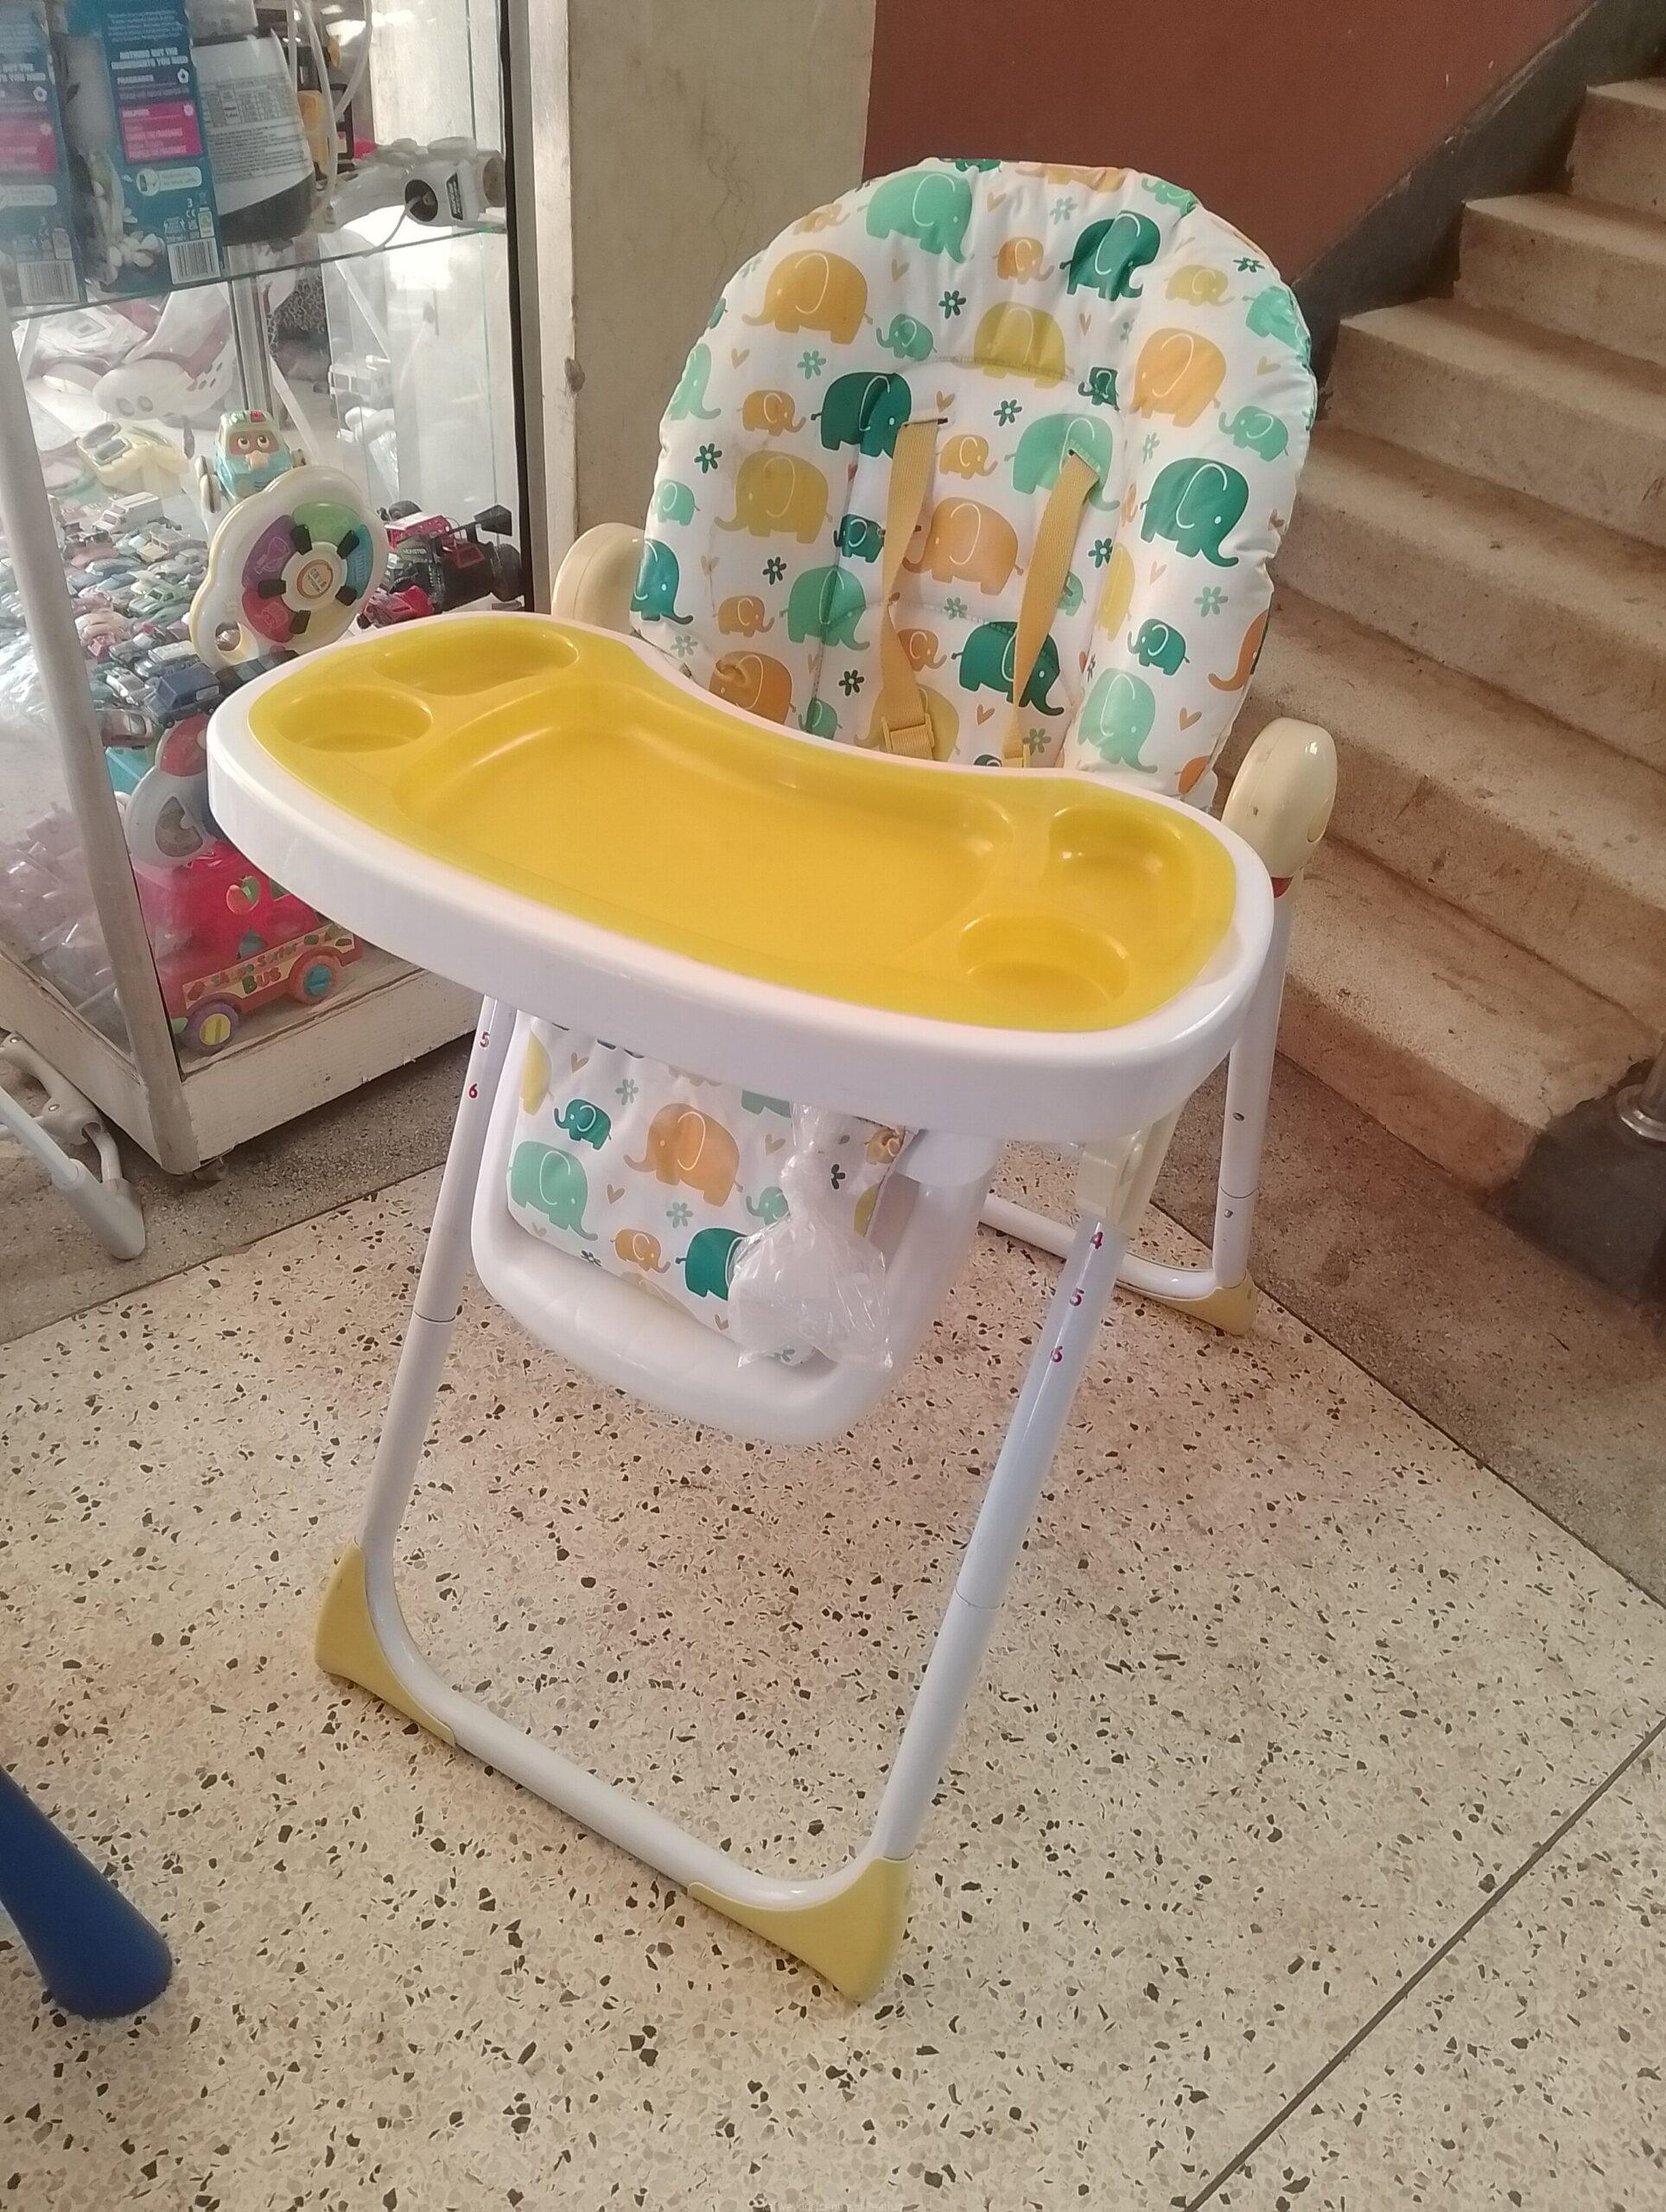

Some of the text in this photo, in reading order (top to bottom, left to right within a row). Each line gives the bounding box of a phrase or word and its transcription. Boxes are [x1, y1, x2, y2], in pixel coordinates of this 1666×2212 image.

[480, 1031, 490, 1048] 5
[468, 1083, 478, 1099] 6
[1090, 1231, 1103, 1249] 4
[1069, 1287, 1084, 1306] 5
[1050, 1345, 1063, 1363] 6
